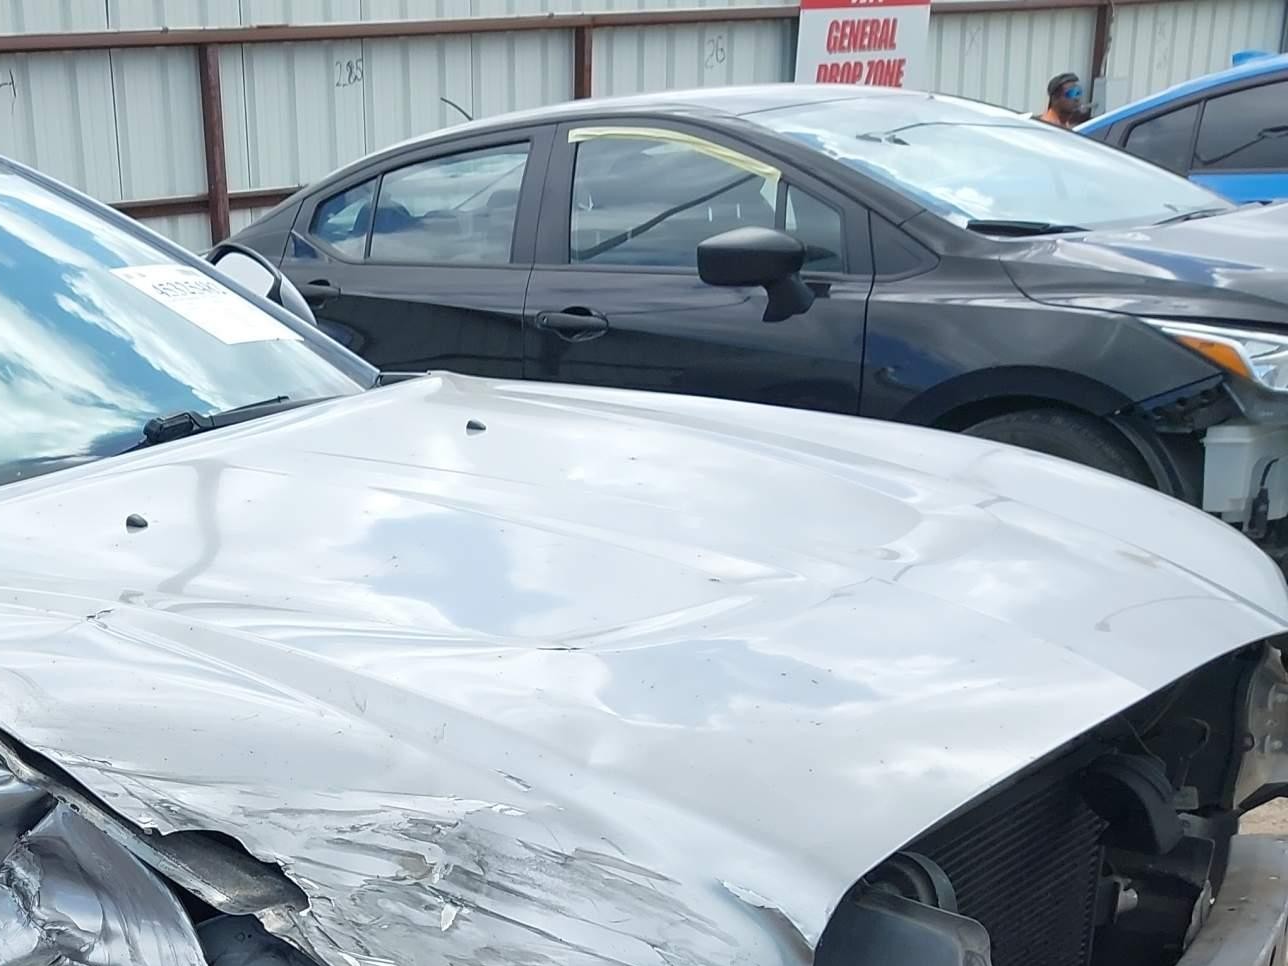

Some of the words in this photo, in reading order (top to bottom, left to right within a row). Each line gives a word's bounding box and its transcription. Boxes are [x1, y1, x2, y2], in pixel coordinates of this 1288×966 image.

[826, 18, 898, 54] GENERAL
[816, 61, 863, 84] DROP
[864, 59, 906, 88] ZONE
